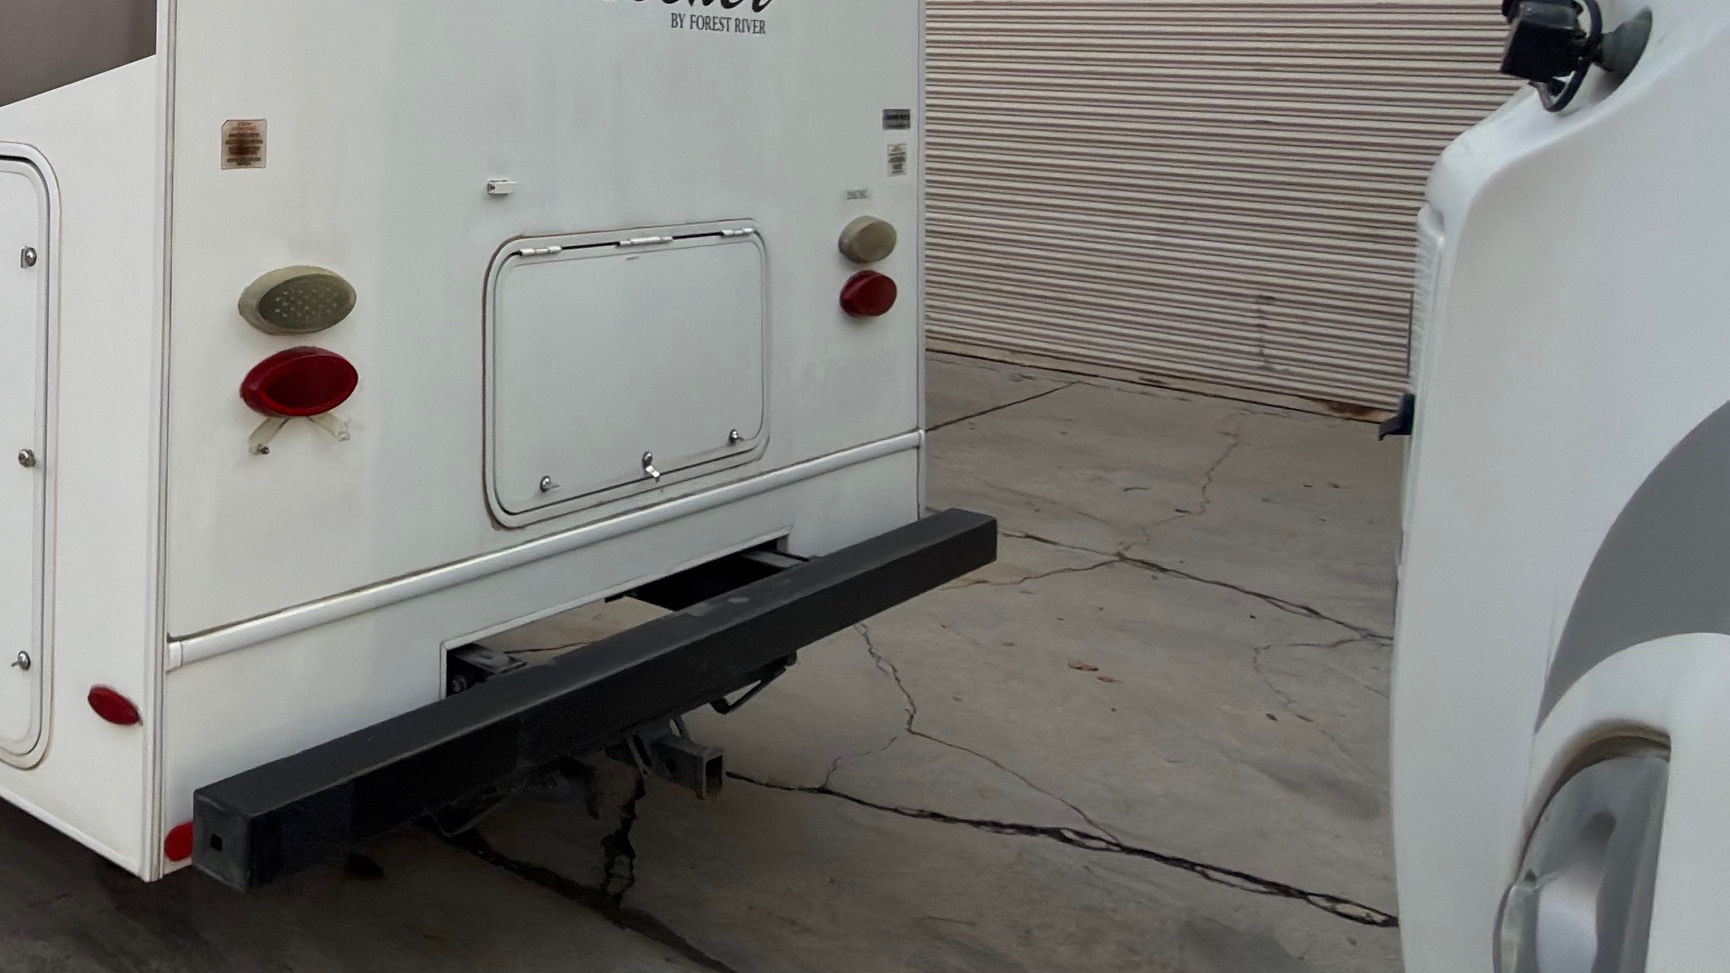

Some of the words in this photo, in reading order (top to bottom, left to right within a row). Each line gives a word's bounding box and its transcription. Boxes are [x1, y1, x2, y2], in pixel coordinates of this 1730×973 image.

[670, 12, 686, 29] BY
[689, 14, 732, 33] FOREST
[734, 17, 767, 35] RIVER
